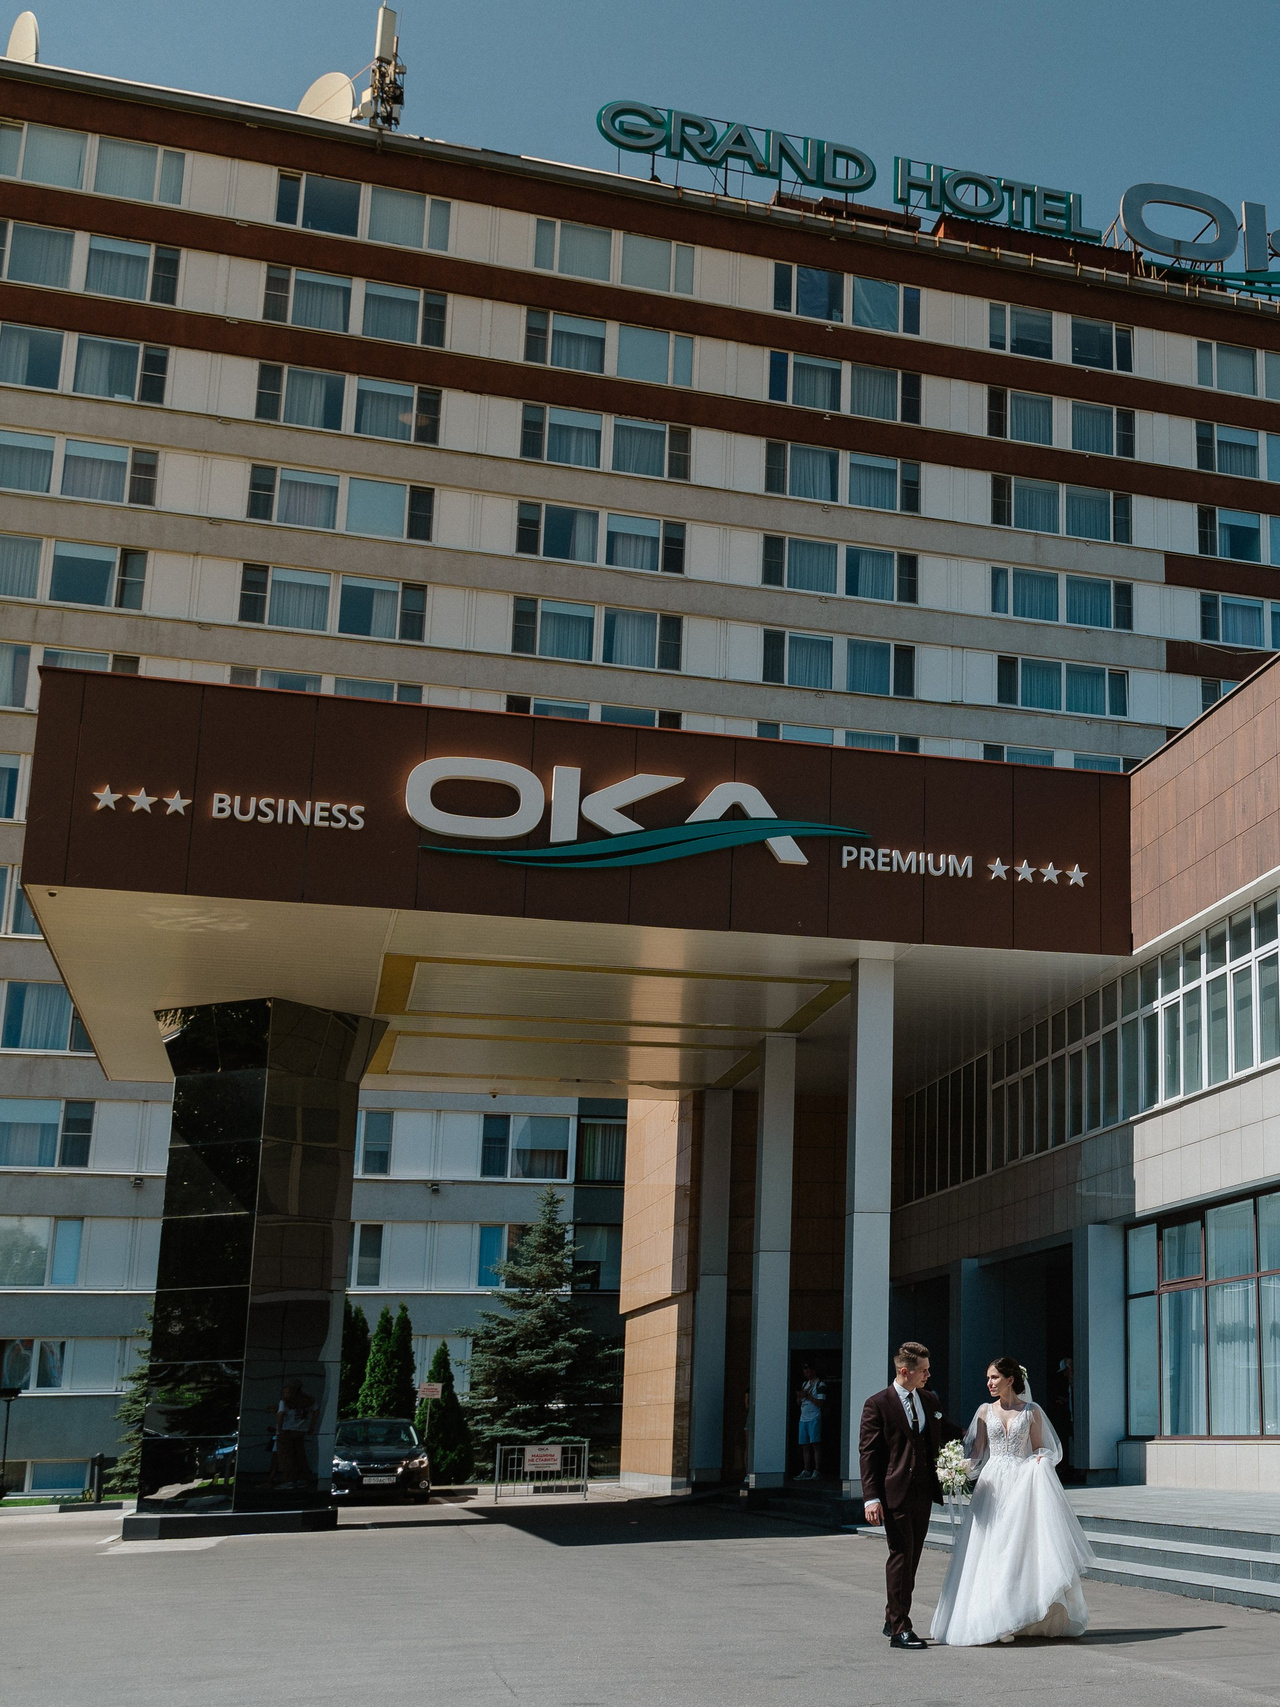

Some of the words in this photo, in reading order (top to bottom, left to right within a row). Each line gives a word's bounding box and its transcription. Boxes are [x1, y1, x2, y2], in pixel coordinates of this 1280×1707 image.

[596, 100, 877, 194] GRAND
[893, 156, 1103, 244] HOTEL
[212, 792, 366, 831] BUSINESS
[405, 756, 809, 866] OKA
[841, 845, 973, 878] PREMIUM
